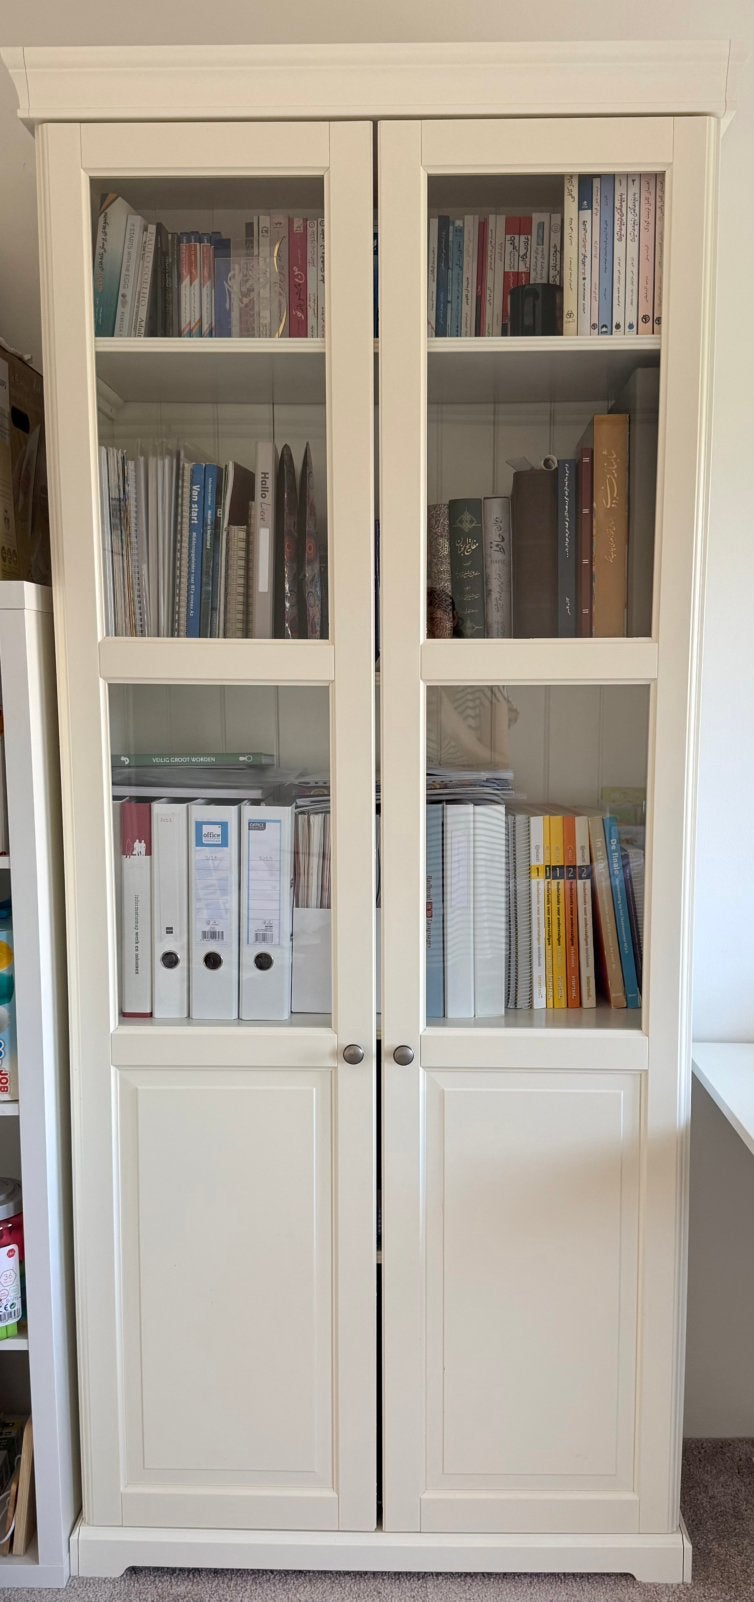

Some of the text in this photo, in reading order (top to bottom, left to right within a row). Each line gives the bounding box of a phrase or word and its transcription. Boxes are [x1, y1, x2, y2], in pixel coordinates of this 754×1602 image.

[145, 231, 155, 264] PAULO
[140, 265, 150, 307] COELHO
[602, 449, 618, 477] شاهنامه
[261, 472, 269, 499] Hallo
[191, 485, 200, 524] Van start
[490, 532, 506, 556] حافظ
[610, 838, 621, 875] De finale
[535, 867, 540, 877] 1
[556, 867, 560, 877] 1
[568, 868, 574, 877] 2
[581, 868, 587, 877] 2
[0, 1069, 9, 1093] JOB
